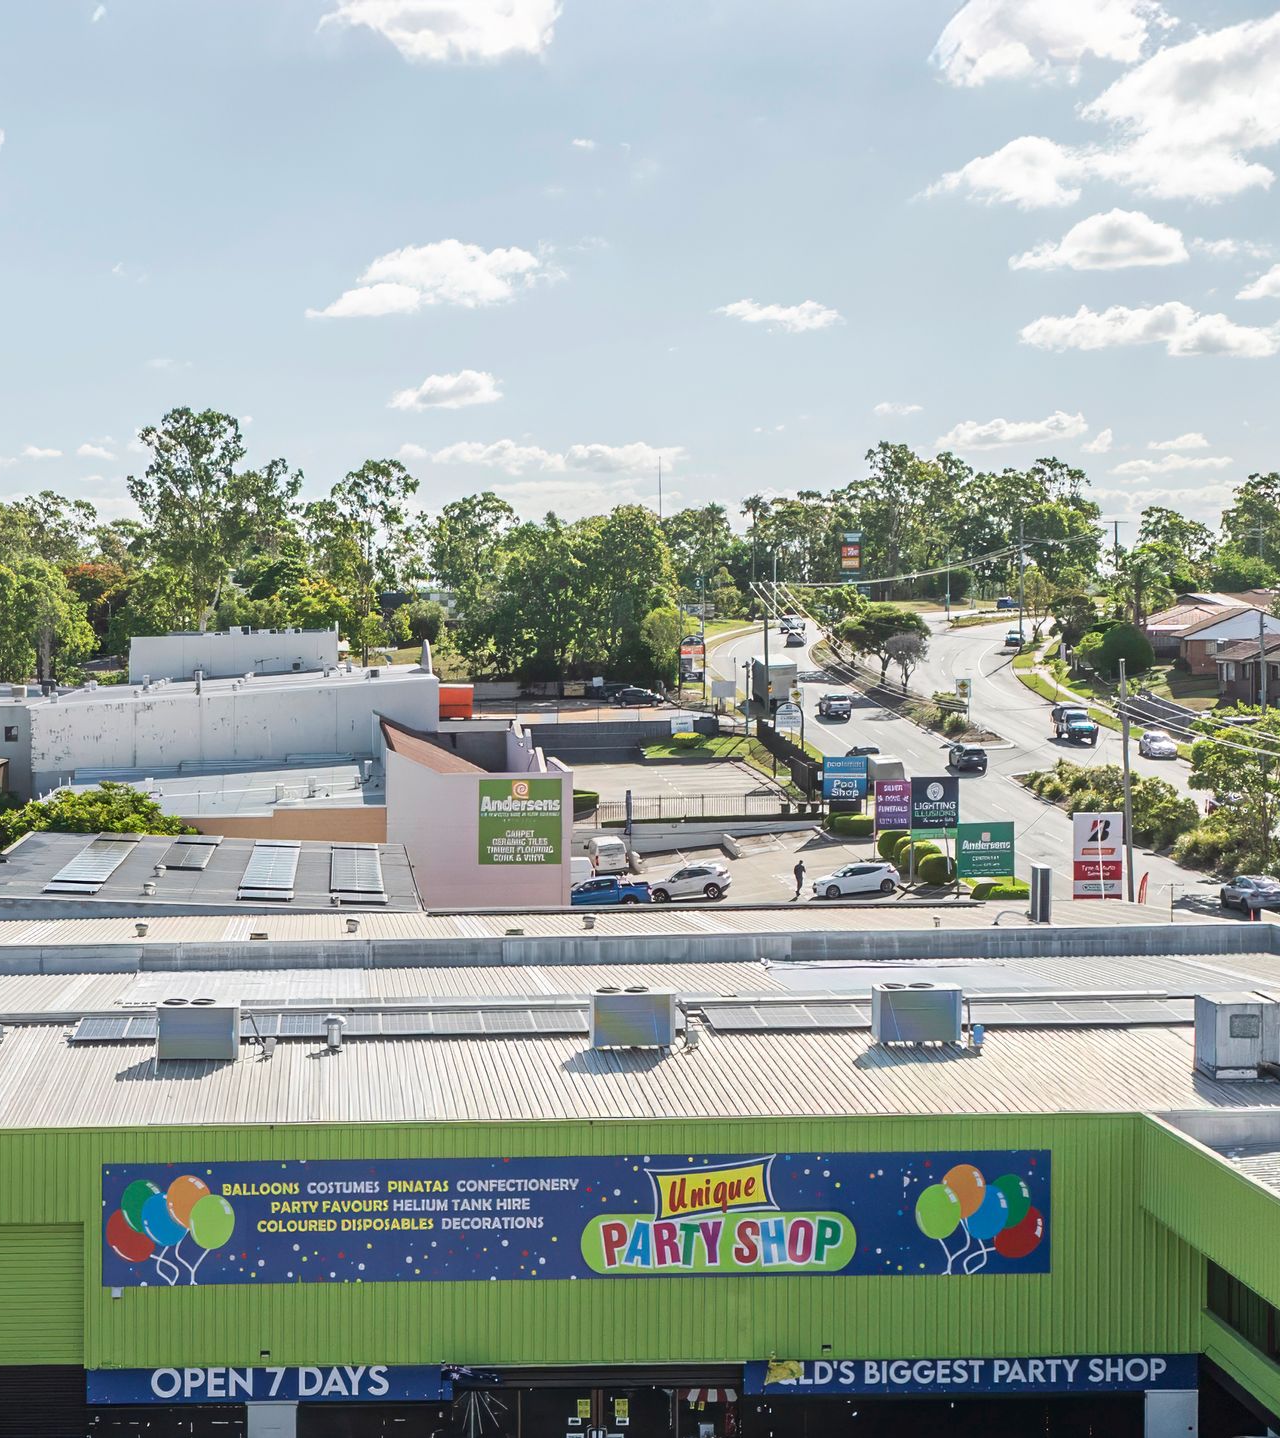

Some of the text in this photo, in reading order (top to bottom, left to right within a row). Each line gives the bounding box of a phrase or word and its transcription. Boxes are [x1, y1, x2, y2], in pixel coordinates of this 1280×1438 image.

[833, 780, 857, 788] Pool
[831, 788, 860, 799] Shop
[481, 795, 561, 812] Andersens
[914, 802, 957, 810] LIGHTING
[492, 838, 549, 846] CERAMIC TILES
[505, 830, 535, 838] CARPET
[524, 854, 546, 862] VINYL
[222, 1178, 580, 1196] BALLOONS COSTUMES PINATAS CONFECTIONERY
[668, 1175, 757, 1213] Unique
[271, 1198, 531, 1214] PARTY FAVOURS HELIUM TANK HIRE
[256, 1216, 544, 1233] COLOURED DISPOSABLES DECORATIONS
[600, 1217, 843, 1270] PARTY SHOP
[779, 1357, 1168, 1386] LD'S BIGGEST PARTY SHOP
[150, 1365, 391, 1399] OPEN 7 DAYS
